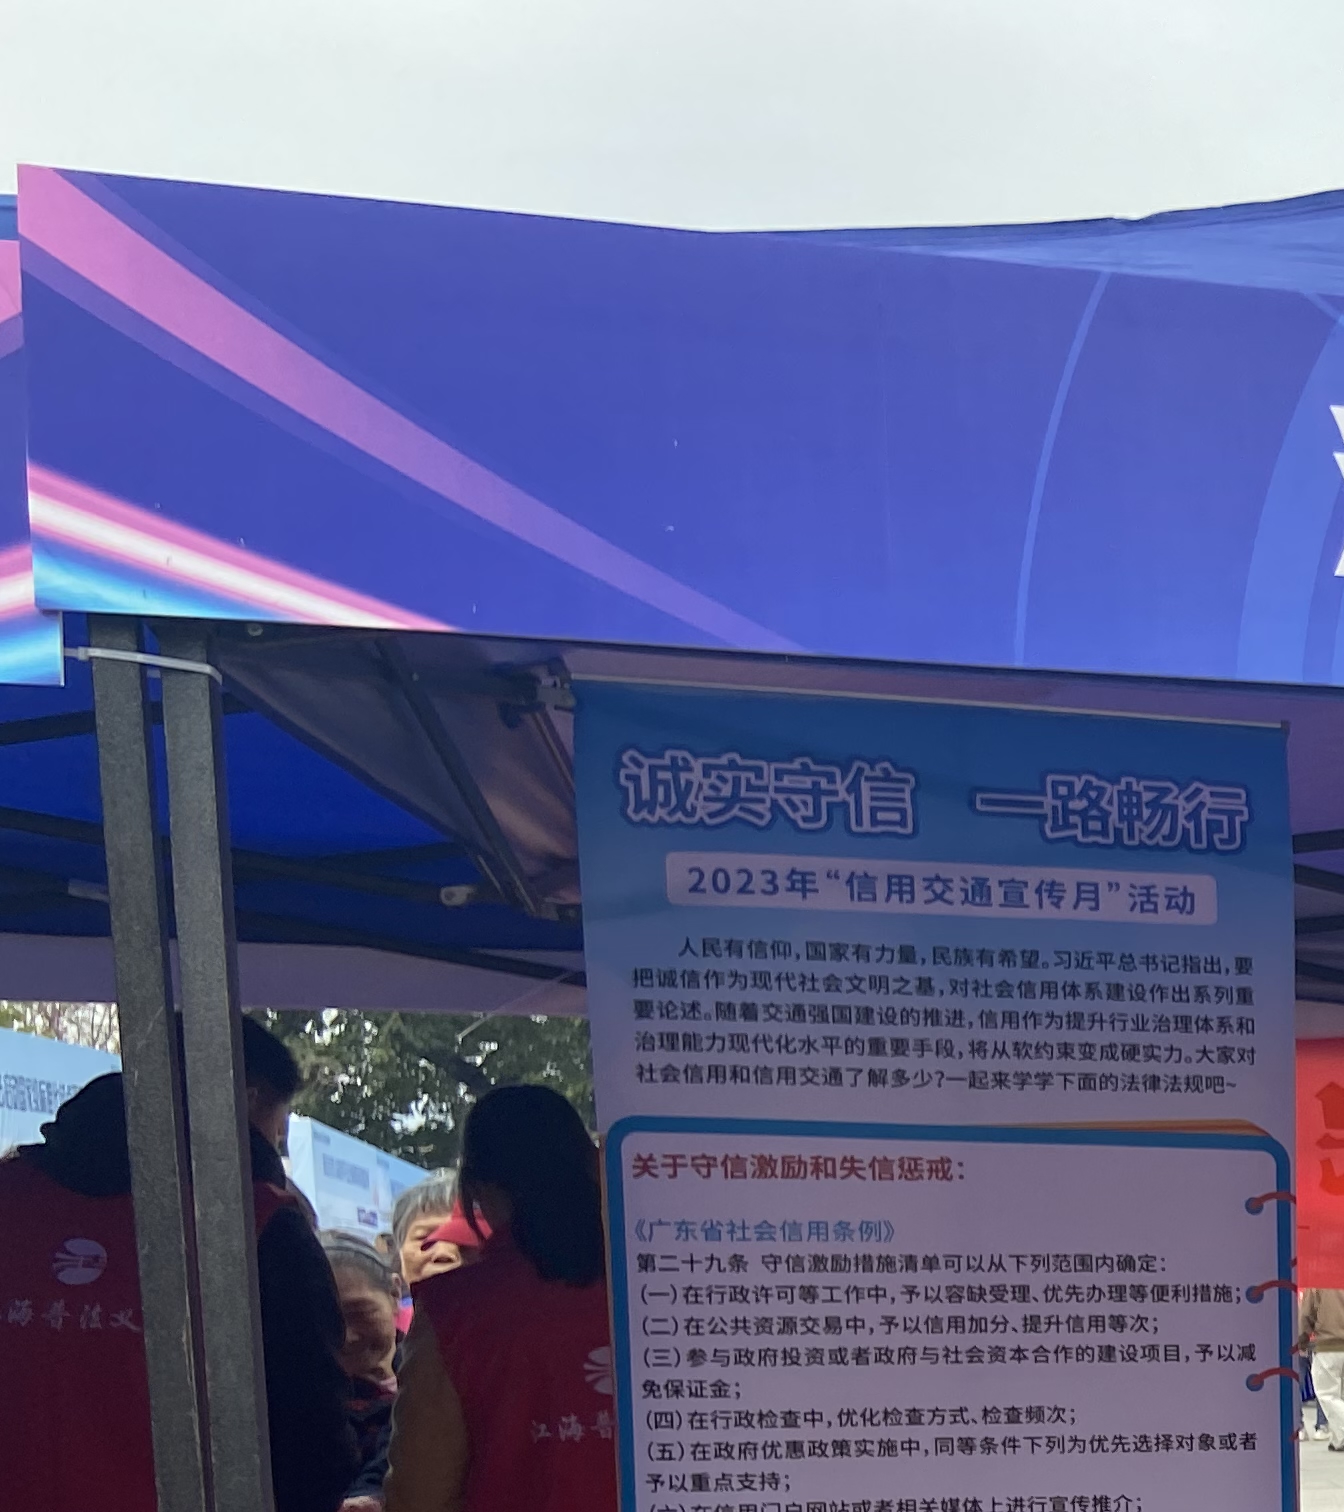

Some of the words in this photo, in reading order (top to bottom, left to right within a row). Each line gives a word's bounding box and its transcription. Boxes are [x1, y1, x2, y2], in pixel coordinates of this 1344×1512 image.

[621, 750, 914, 836] 诚实守信
[972, 771, 1249, 850] 一路畅行
[687, 866, 1196, 917] 2023年“信用交通宣传月”活动
[632, 1153, 965, 1182] 关于守信激励和失信惩戒：
[635, 1218, 896, 1243] 《广东省社会信用条例》
[642, 1379, 742, 1401] 免保证金；
[646, 1472, 791, 1493] 予以重点支持；
